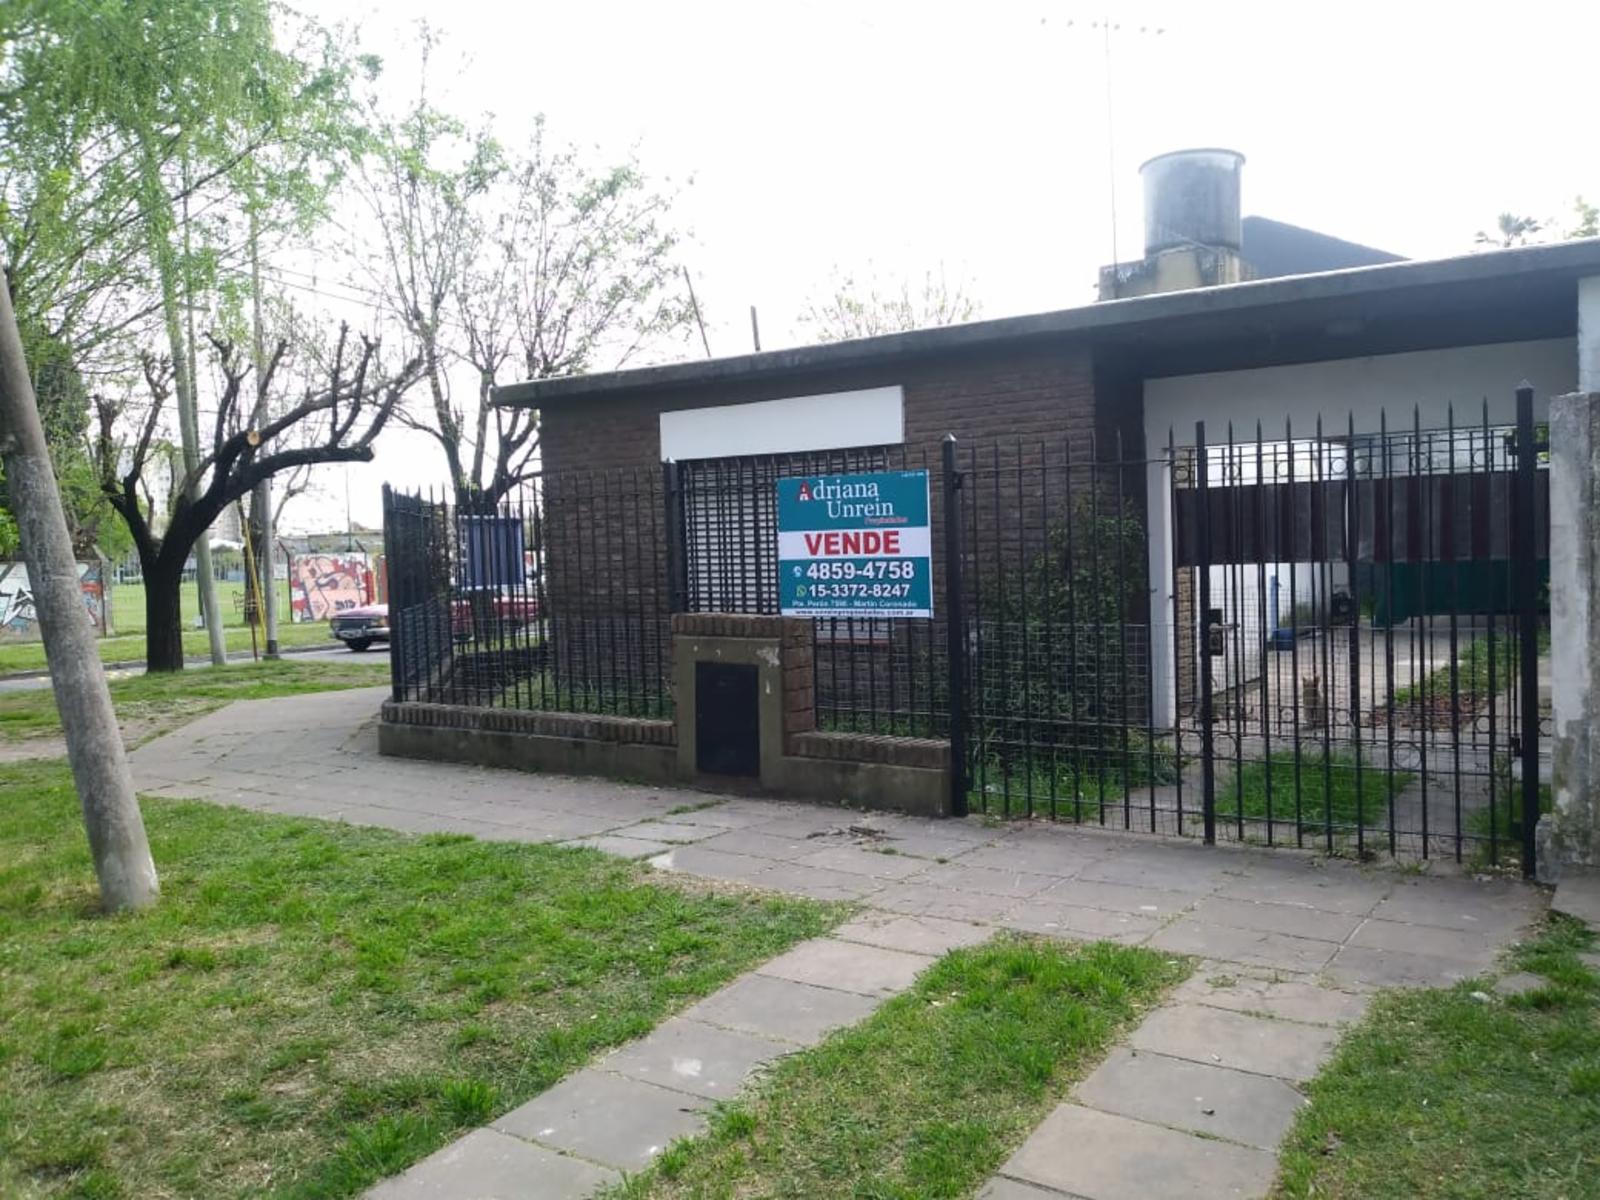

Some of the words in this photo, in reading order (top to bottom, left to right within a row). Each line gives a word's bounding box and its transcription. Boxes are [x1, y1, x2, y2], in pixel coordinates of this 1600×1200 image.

[796, 479, 879, 501] Adriana
[826, 498, 894, 519] Unrein
[803, 530, 901, 556] VENDE
[806, 561, 914, 580] 4859-4758
[809, 584, 910, 598] 15-3372-8247
